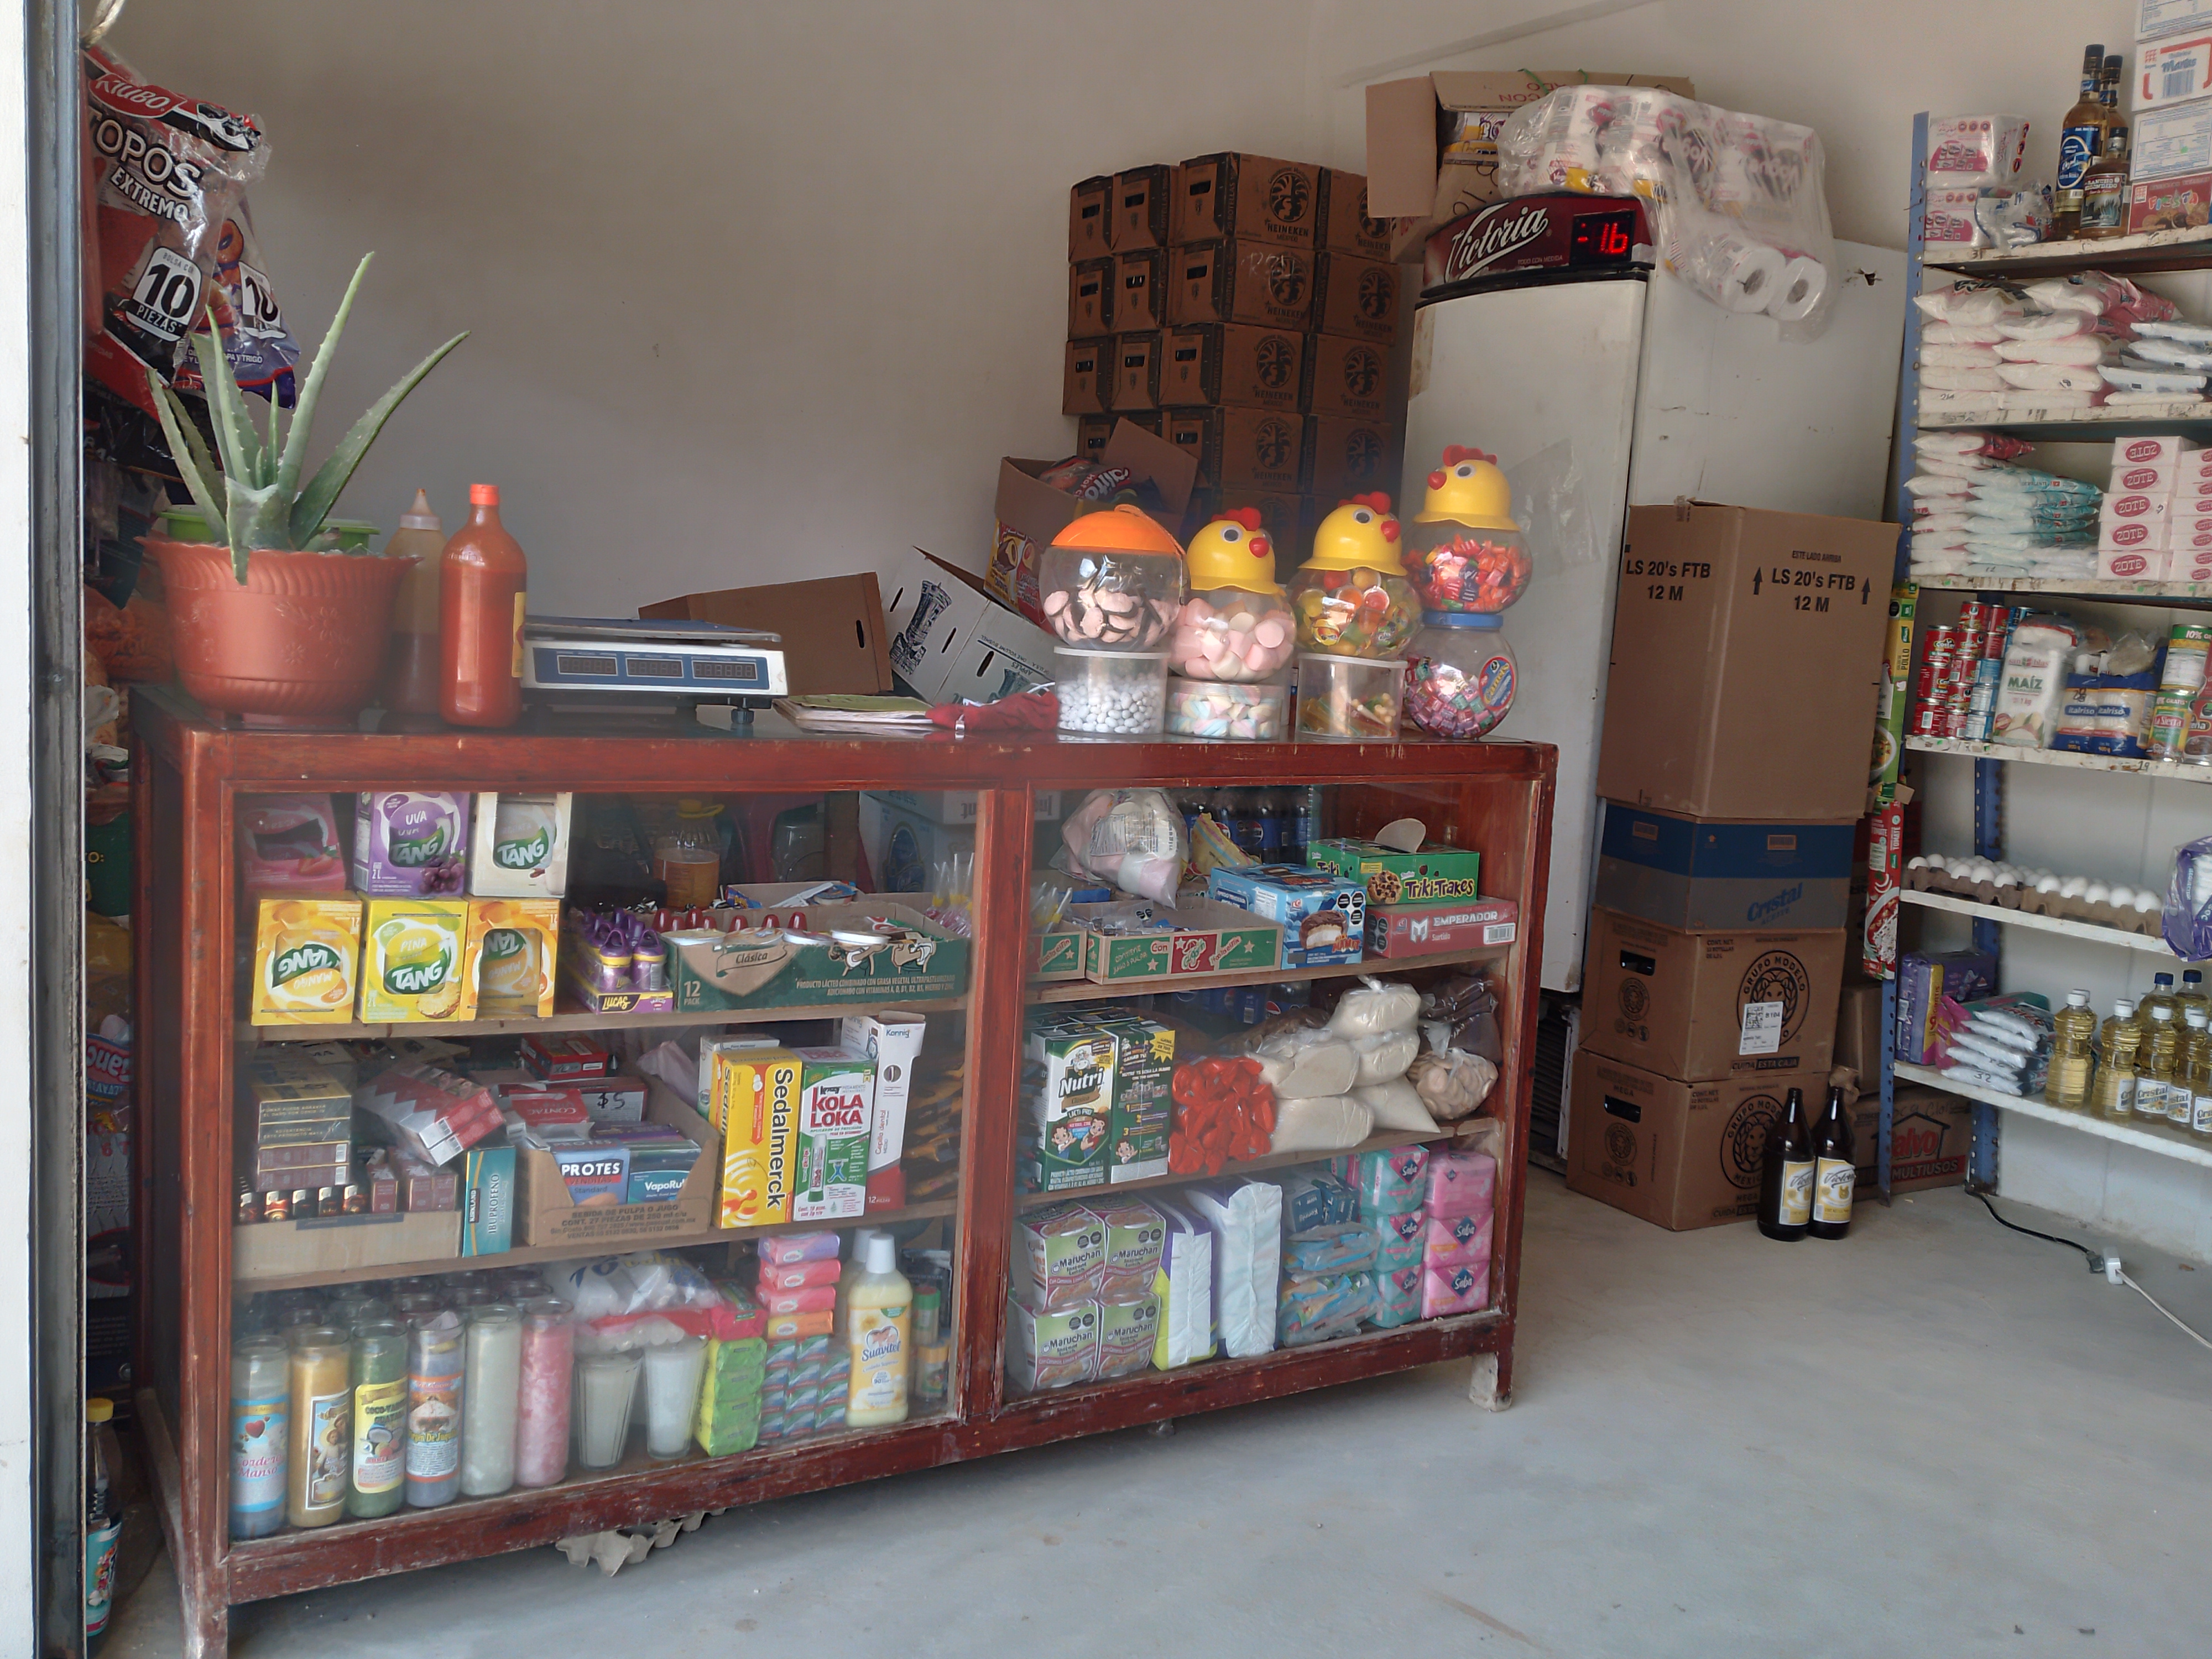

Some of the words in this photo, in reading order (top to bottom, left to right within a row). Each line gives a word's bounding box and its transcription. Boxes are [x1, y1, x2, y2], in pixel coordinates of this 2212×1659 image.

[111, 167, 189, 222] EXTREMO
[1228, 182, 1236, 221] BOTELLAS
[1268, 224, 1309, 237] HEINEKEN
[1444, 202, 1548, 283] Victoria
[145, 263, 195, 319] 10
[1225, 266, 1234, 304] BOTELLAS
[137, 306, 179, 333] PIEZAS
[1255, 389, 1293, 400] HEINEKEN
[1344, 398, 1380, 409] HEINEKEN
[2130, 444, 2158, 458] ZOTE
[2127, 472, 2154, 486] ZOTE
[2119, 499, 2147, 513] ZOTE
[2116, 527, 2144, 542] ZOTE
[1792, 550, 1806, 559] ESTE
[1806, 551, 1821, 561] LADO
[1626, 560, 1644, 575] LS
[1647, 561, 1677, 577] 20's
[1681, 562, 1711, 578] FTB
[2115, 558, 2143, 572] ZOTE
[1772, 568, 1790, 585] LS
[1794, 571, 1824, 588] 20's
[1828, 574, 1855, 591] FTB
[1647, 585, 1664, 600] 12
[1669, 586, 1684, 601] M
[1794, 596, 1811, 611] 12
[1815, 597, 1830, 612] M
[1902, 648, 1911, 671] POLLO
[1011, 661, 1034, 676] APPLES
[2007, 675, 2043, 690] MAÍZ
[2068, 706, 2095, 714] italriso
[2098, 706, 2125, 715] italriso
[2138, 760, 2151, 772] 19
[405, 811, 427, 825] UVA
[390, 837, 437, 864] TANG
[498, 838, 545, 865] TANG
[1405, 877, 1475, 899] Triki-Trakes
[1746, 881, 1803, 922] Cristal
[1433, 911, 1498, 927] EMPERADOR
[484, 932, 520, 955] TAN
[1150, 941, 1168, 954] Con
[279, 947, 330, 978] TANG
[735, 951, 768, 964] Clásica
[293, 971, 333, 990] MANGO
[392, 959, 443, 991] TANG
[1744, 958, 1771, 995] GRUPO
[1775, 956, 1806, 992] MODELO
[684, 980, 701, 998] 12
[601, 995, 632, 1011] LUCAS
[1059, 1067, 1104, 1098] Nutri
[812, 1086, 864, 1112] KOLA
[2137, 1085, 2169, 1098] Cristal
[810, 1109, 863, 1128] LOKA
[1727, 1103, 1754, 1138] GRUPO
[766, 1068, 794, 1211] Sedalmerck
[874, 1131, 883, 1155] Cepillo
[1892, 1128, 1939, 1160] alvo
[561, 1162, 621, 1177] PROTES
[1401, 1165, 1418, 1177] Saba
[1891, 1160, 1959, 1181] MULTIUSOS
[569, 1176, 612, 1185] VENDITAS
[574, 1186, 608, 1194] Standard
[487, 1173, 500, 1235] IBUPROFENO
[868, 1196, 877, 1204] 12
[561, 1219, 587, 1227] CONT.
[601, 1215, 631, 1224] PIEZAS
[571, 1211, 603, 1219] BEBIDA
[1401, 1224, 1418, 1235] Saba
[1455, 1225, 1475, 1237] Saba
[1059, 1249, 1101, 1269] Maruchan
[1118, 1246, 1159, 1259] Maruchan
[1454, 1277, 1473, 1290] Saba
[1114, 1323, 1153, 1337] Maruchan
[1049, 1331, 1093, 1349] Maruchan
[860, 1341, 901, 1363] Suavitel
[238, 1465, 279, 1479] Manso
